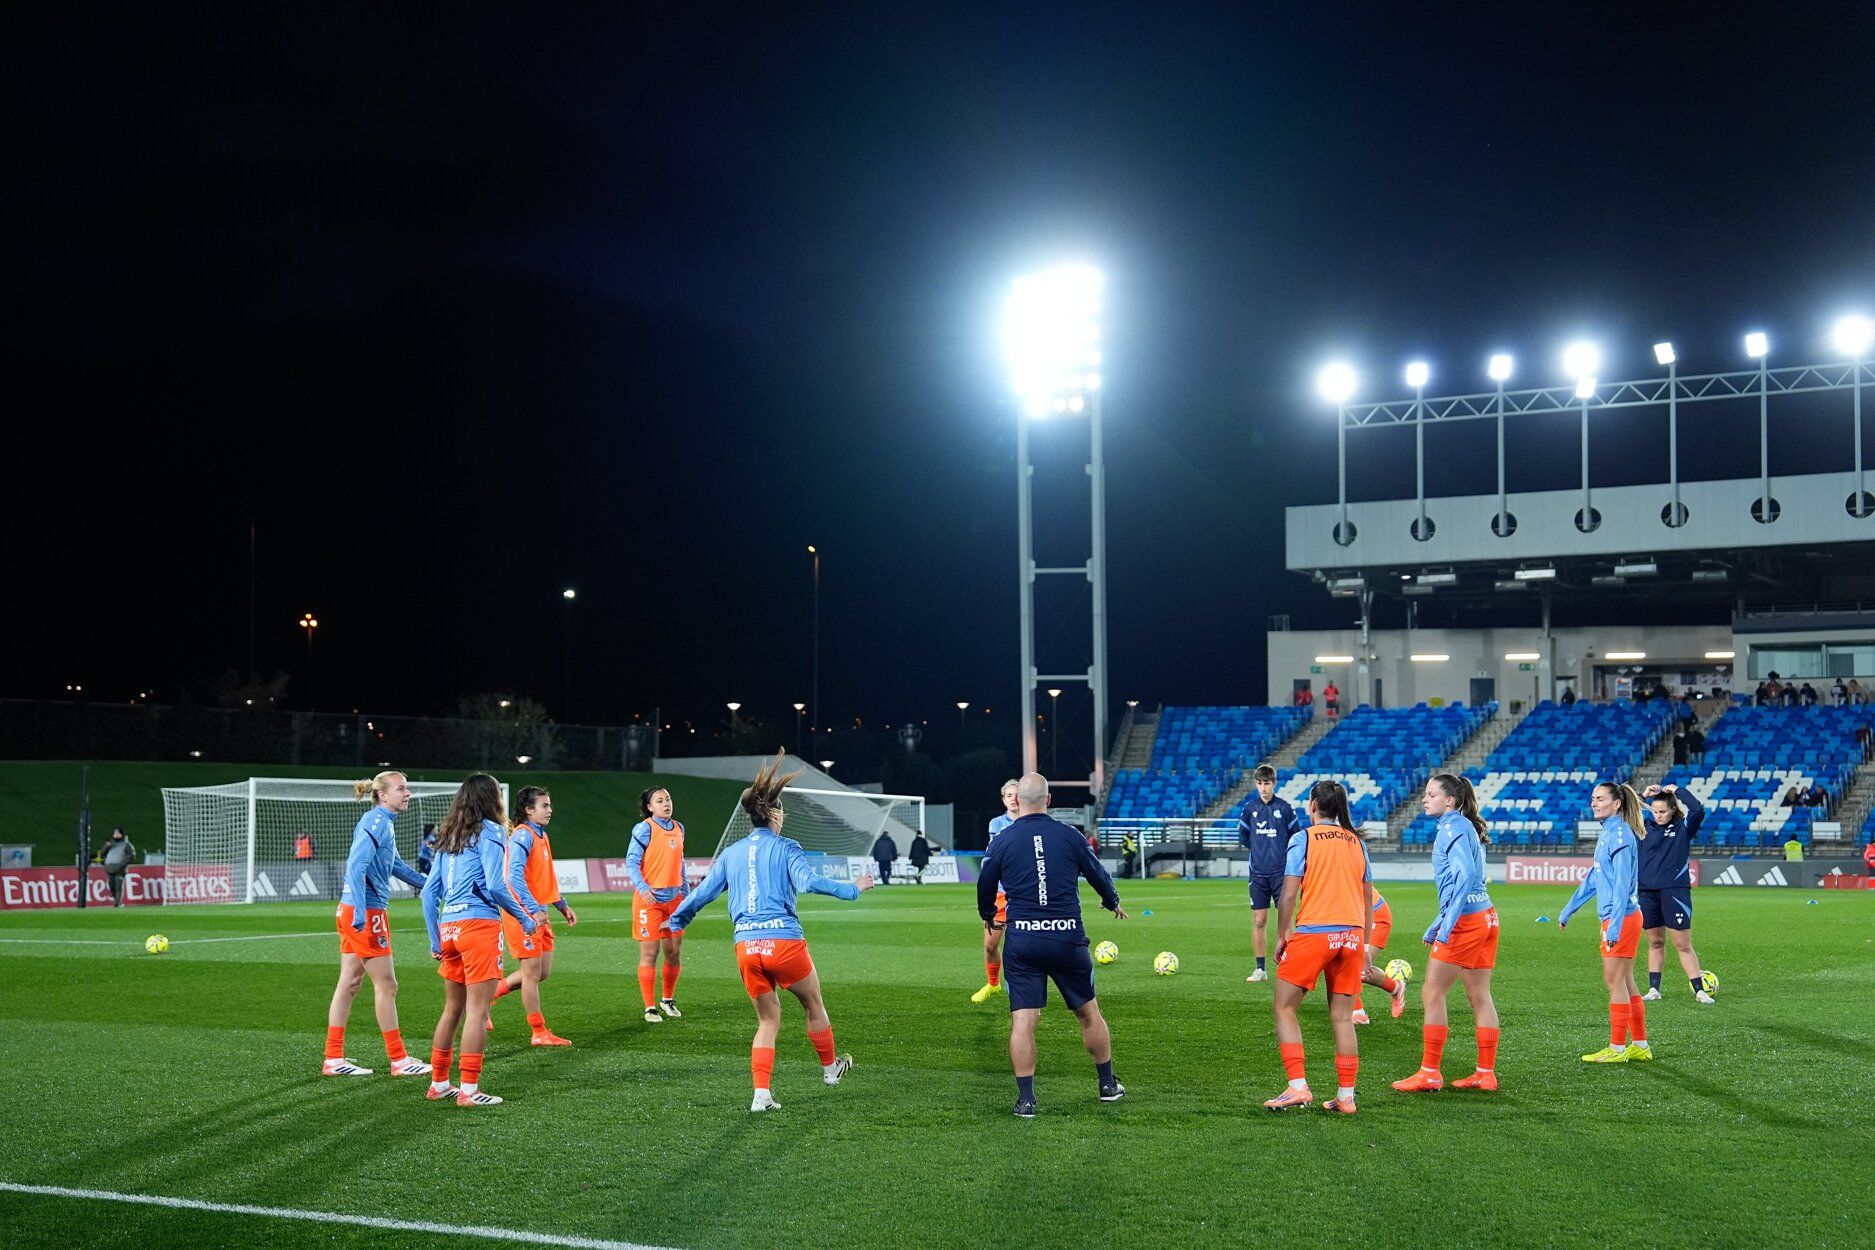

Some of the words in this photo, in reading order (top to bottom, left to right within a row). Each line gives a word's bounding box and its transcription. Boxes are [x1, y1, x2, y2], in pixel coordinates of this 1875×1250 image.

[1315, 831, 1357, 845] macron
[822, 864, 848, 878] BMW
[125, 873, 231, 901] Emirates
[639, 909, 648, 925] 5
[1015, 919, 1076, 931] macron
